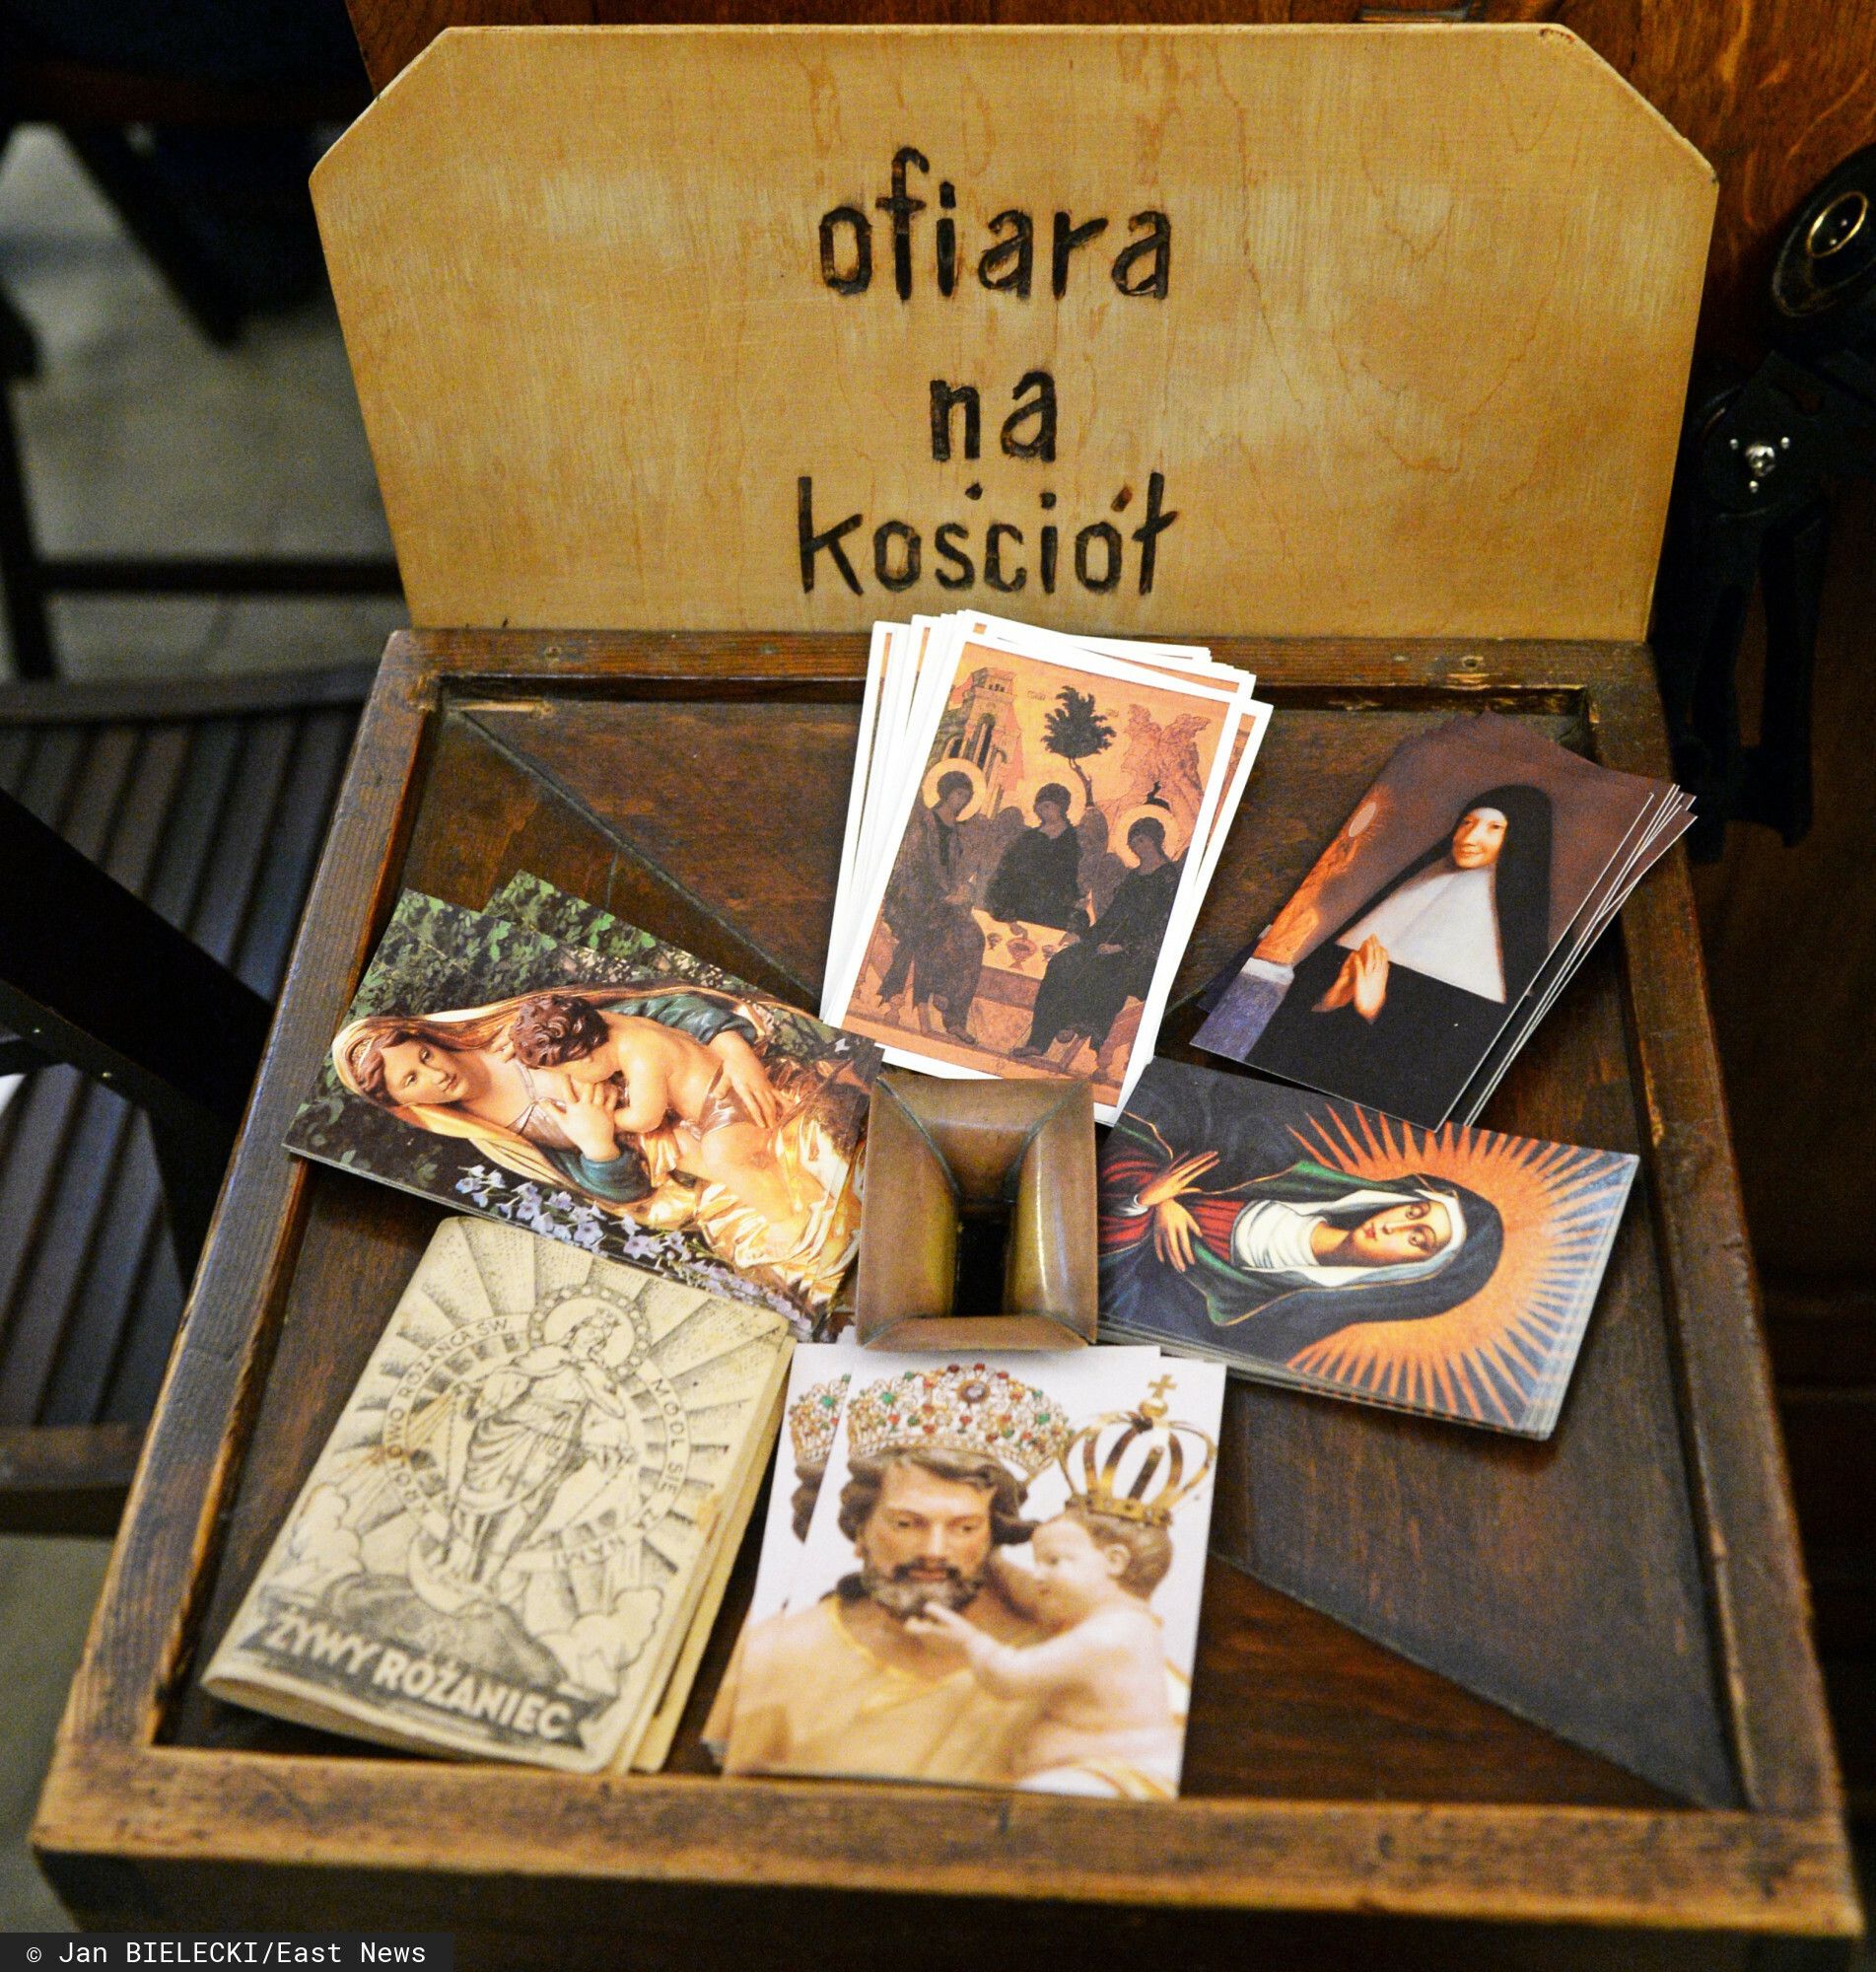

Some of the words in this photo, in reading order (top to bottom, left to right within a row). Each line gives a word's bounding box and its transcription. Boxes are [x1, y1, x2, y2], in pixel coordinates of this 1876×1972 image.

[818, 146, 1171, 300] ofiara
[930, 371, 1058, 462] na
[798, 472, 1178, 596] kościół
